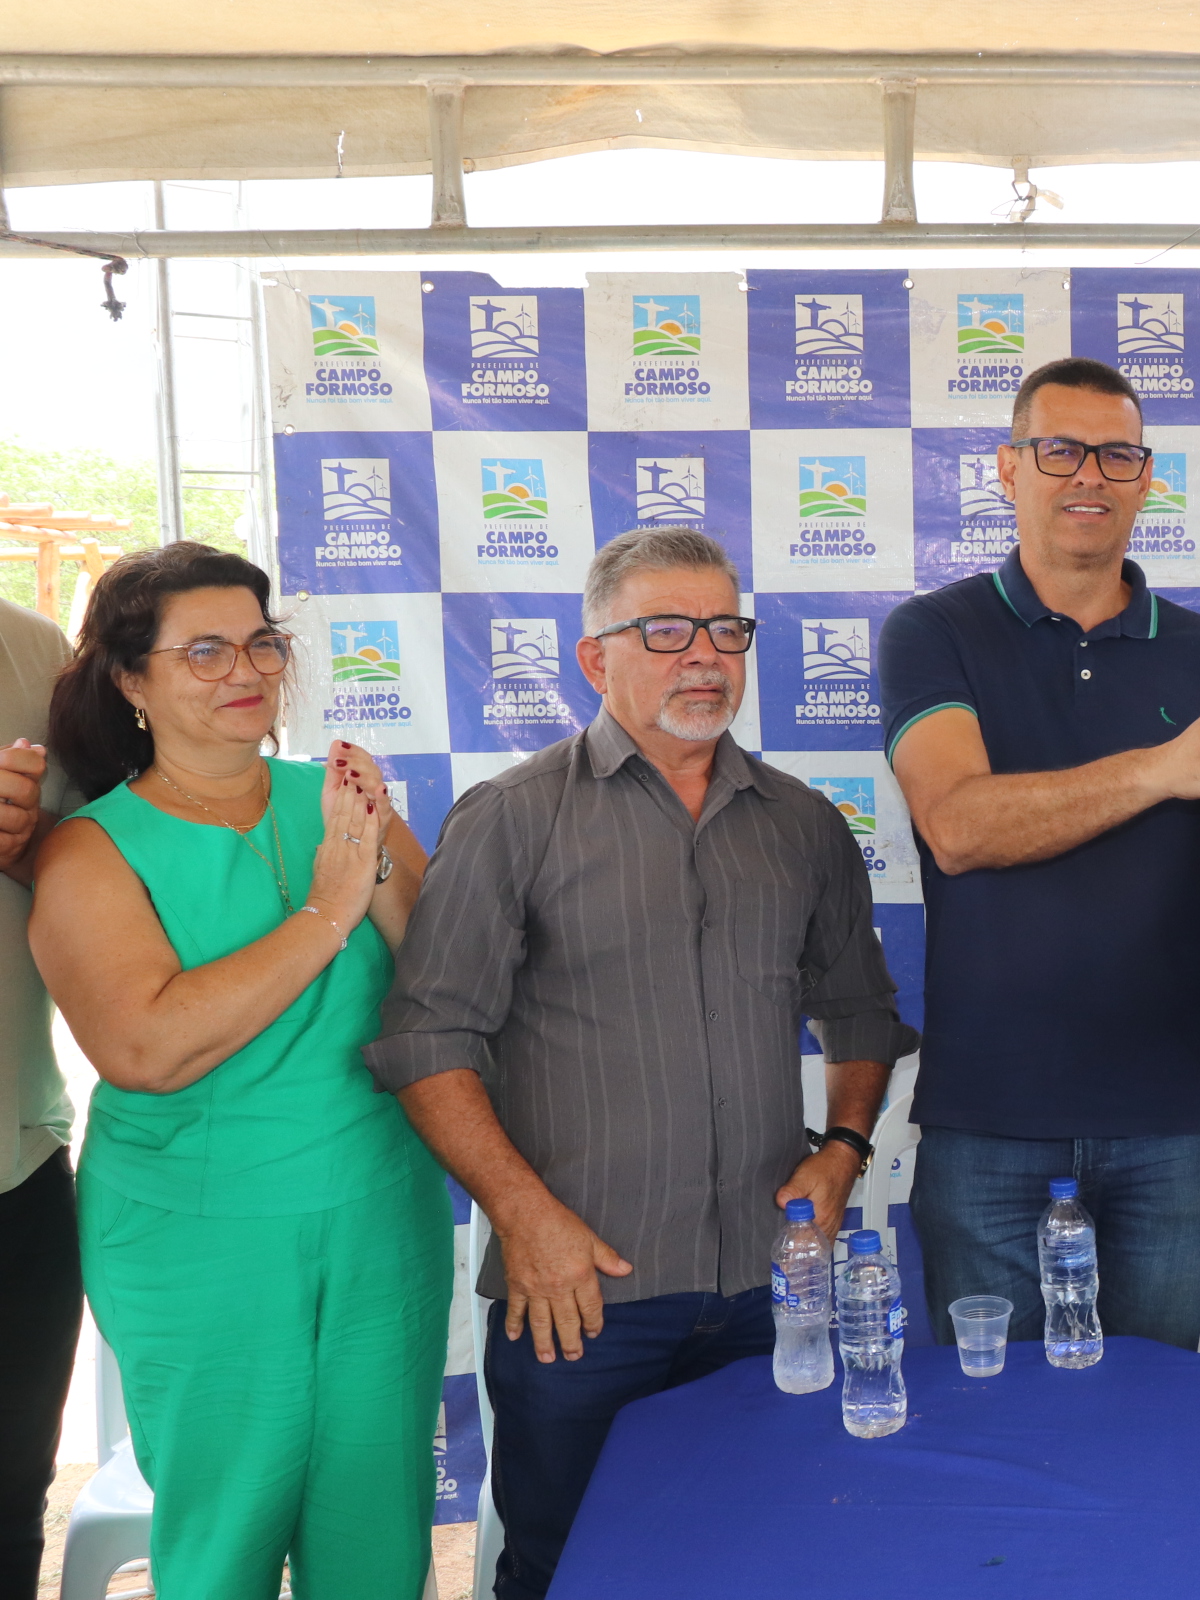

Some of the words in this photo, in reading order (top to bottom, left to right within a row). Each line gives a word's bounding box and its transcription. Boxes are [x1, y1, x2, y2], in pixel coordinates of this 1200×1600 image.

[315, 368, 382, 382] CAMPO
[472, 370, 538, 383] CAMPO
[634, 367, 700, 382] CAMPO
[796, 366, 862, 380] CAMPO
[958, 365, 1023, 378] CAMPO
[1118, 364, 1183, 378] CAMPO
[306, 382, 393, 397] FORMOSO
[461, 383, 549, 397] FORMOSO
[624, 381, 711, 397] FORMOSO
[786, 379, 873, 394] FORMOSO
[948, 379, 1020, 392] FORMOS
[1130, 378, 1194, 391] RMOSO
[325, 531, 391, 546] CAMPO
[485, 531, 548, 545] CAMPO
[800, 528, 865, 543] CAMPO
[1132, 525, 1185, 538] AMPO
[315, 544, 402, 561] FORMOSO
[477, 544, 559, 559] FORMOSO
[790, 542, 876, 558] FORMOSO
[333, 692, 401, 709] CAMPO
[493, 690, 559, 704] CAMPO
[805, 690, 869, 705] CAMPO
[323, 705, 412, 723] FORMOSO
[483, 703, 570, 718] FORMOSO
[795, 703, 881, 718] FORMOSO
